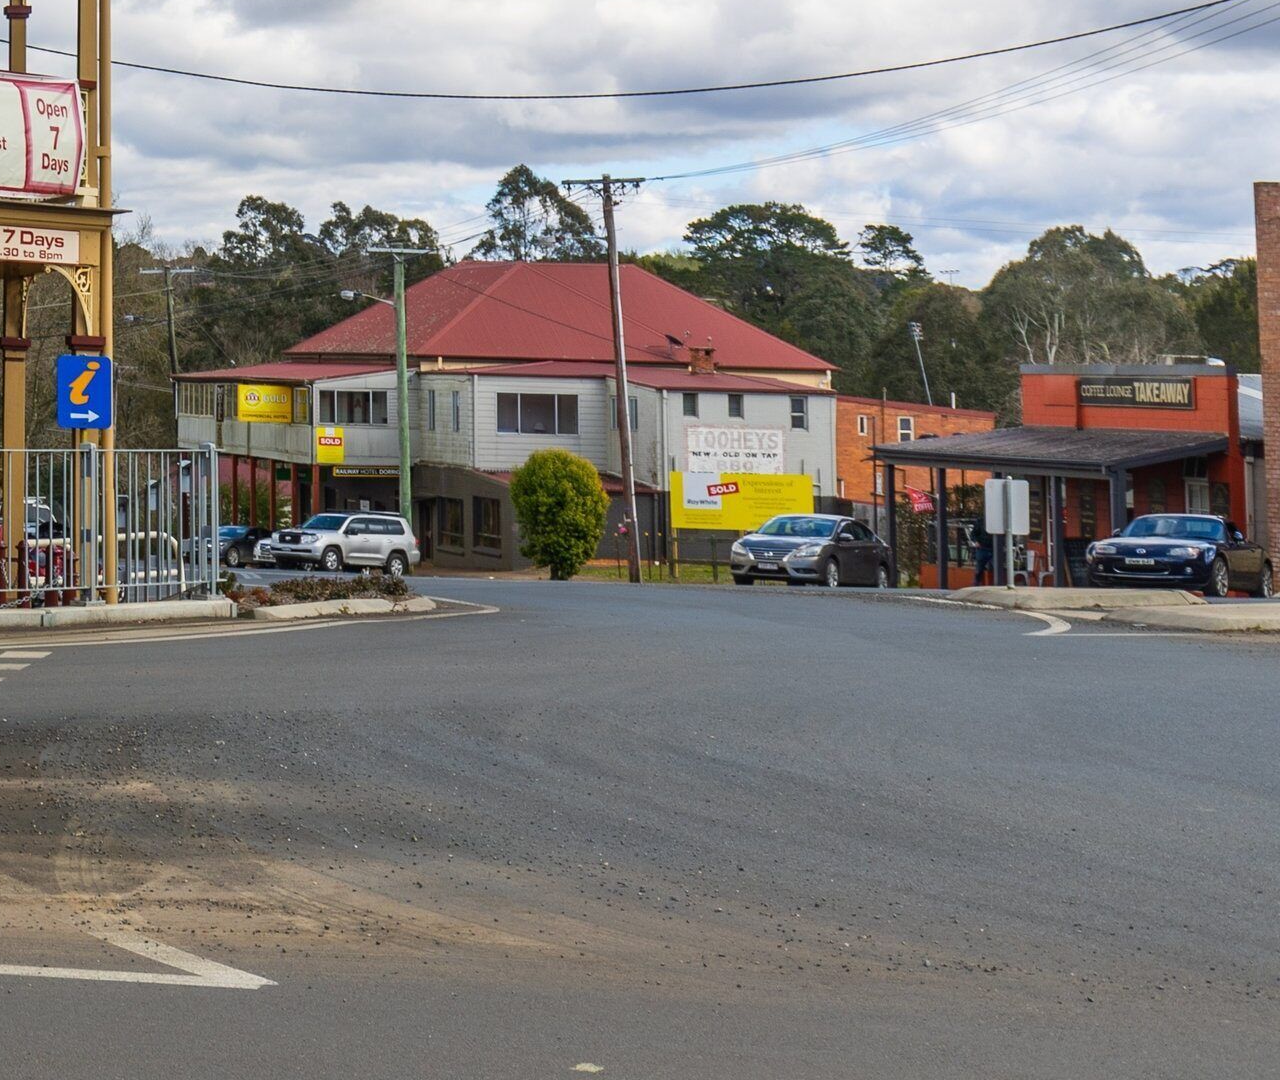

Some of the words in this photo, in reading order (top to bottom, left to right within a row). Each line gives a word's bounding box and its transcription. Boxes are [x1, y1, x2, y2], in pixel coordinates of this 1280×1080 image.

[36, 98, 68, 119] Open
[49, 125, 60, 150] 7
[41, 153, 69, 175] Days
[3, 228, 16, 244] 7
[20, 230, 65, 250] Days
[23, 249, 35, 258] to
[39, 250, 63, 260] 8pm
[1081, 385, 1105, 397] COFFEE
[1106, 385, 1133, 398] LOUNGE
[1133, 381, 1190, 404] TAKEAWAY
[320, 437, 341, 445] SOLD
[689, 430, 780, 451] TOOHEYS
[710, 483, 737, 495] SOLD
